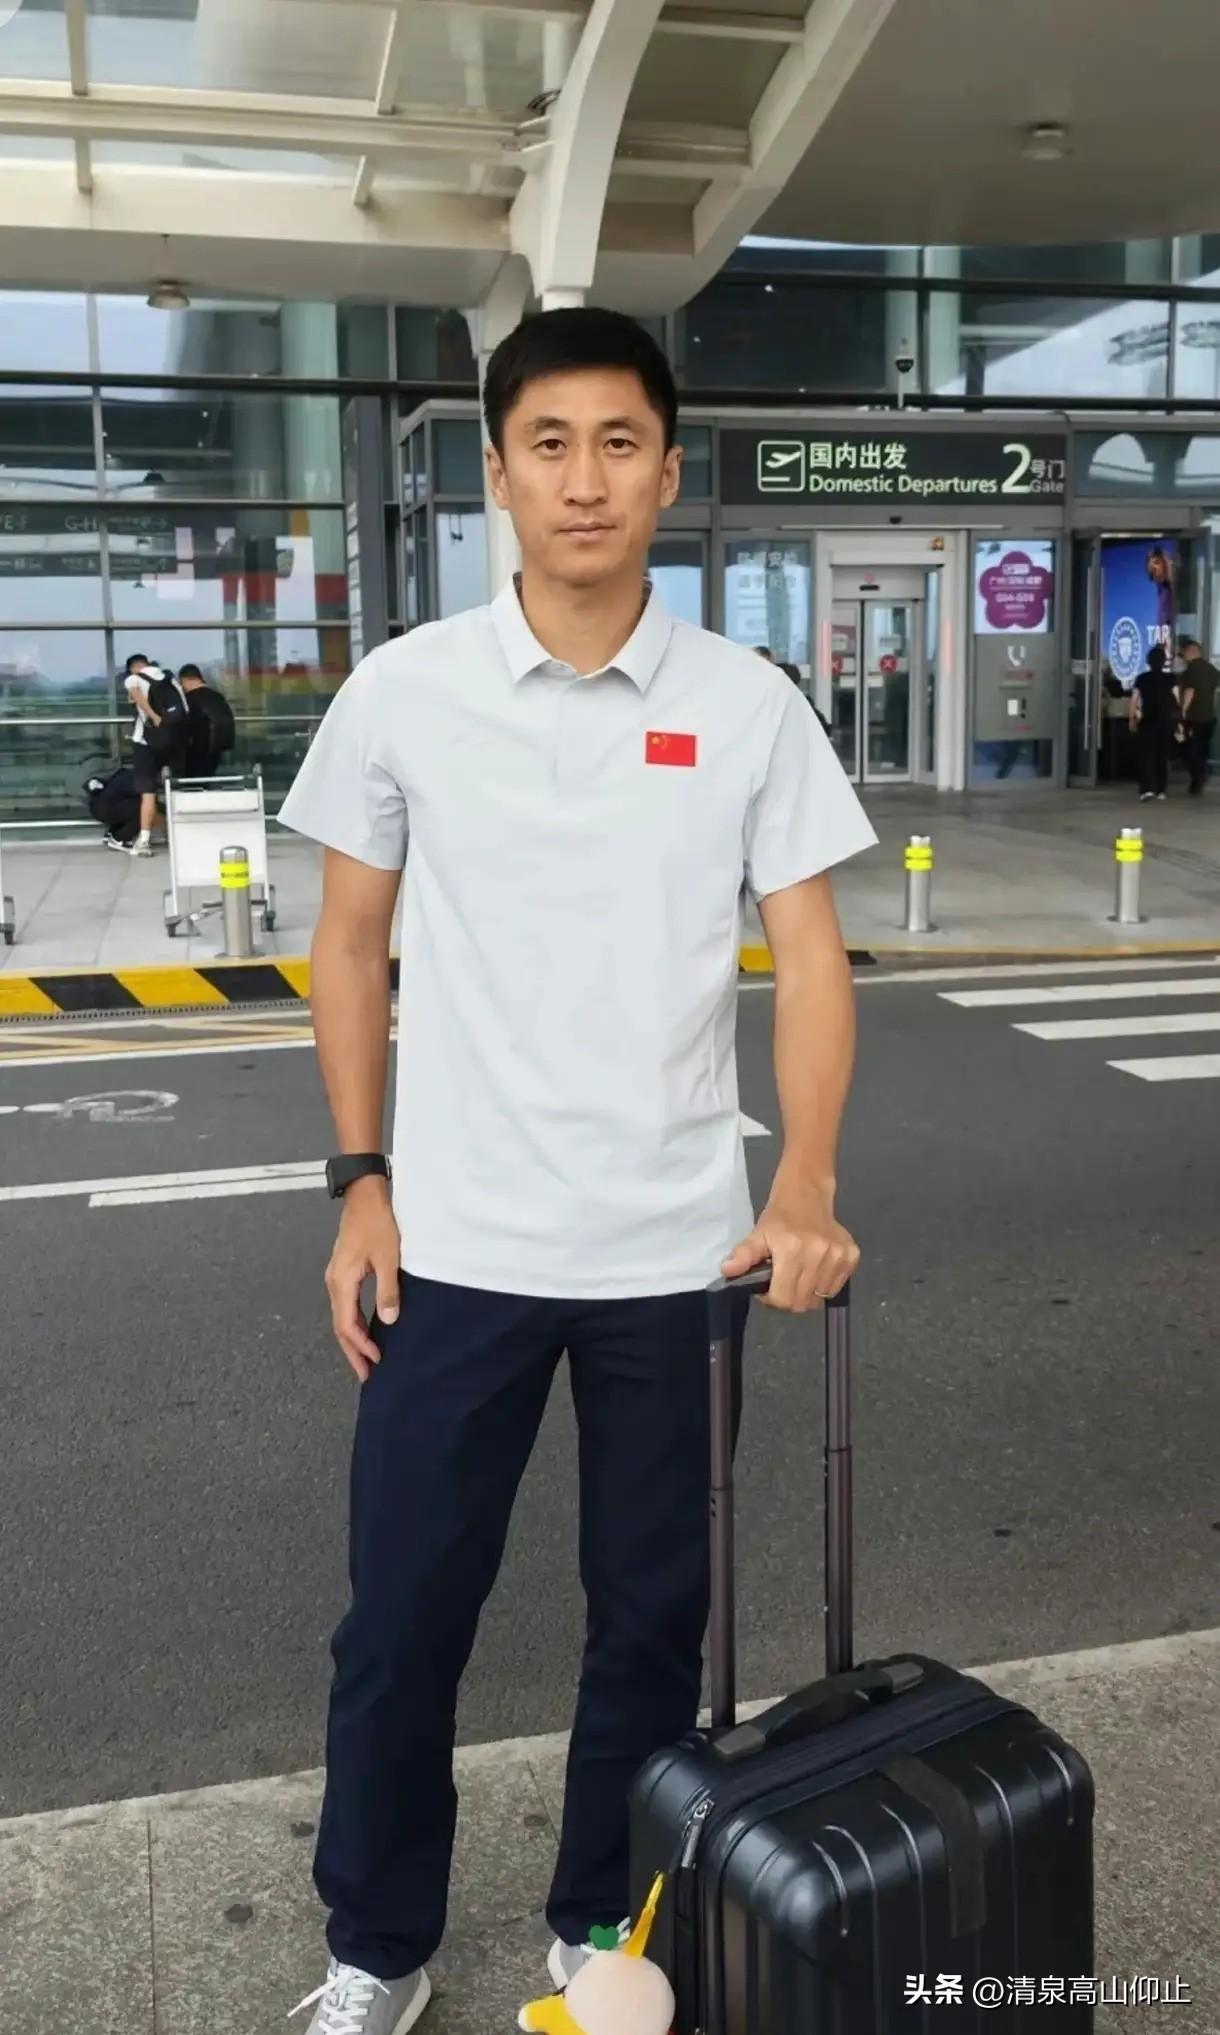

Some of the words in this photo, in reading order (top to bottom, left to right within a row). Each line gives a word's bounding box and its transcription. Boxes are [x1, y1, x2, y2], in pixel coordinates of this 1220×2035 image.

[809, 442, 907, 469] 国内出发
[1001, 443, 1031, 493] 2
[1030, 459, 1065, 479] 号门
[809, 474, 894, 493] Domestic
[898, 474, 997, 497] Departures
[1030, 479, 1065, 493] Gate
